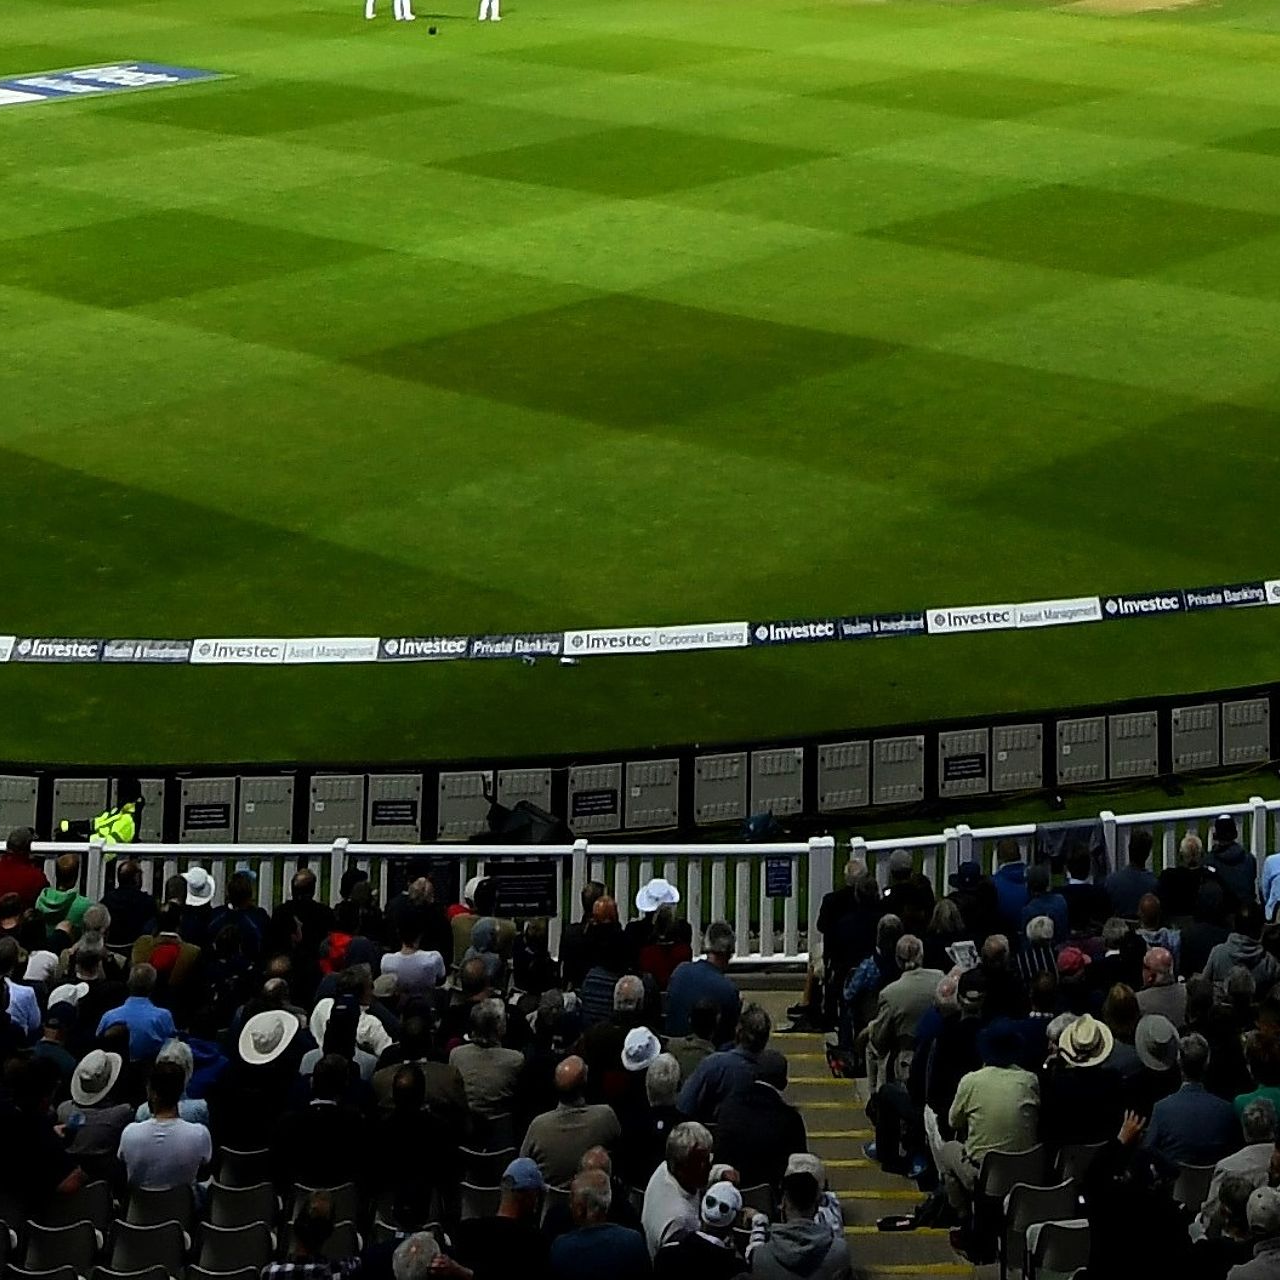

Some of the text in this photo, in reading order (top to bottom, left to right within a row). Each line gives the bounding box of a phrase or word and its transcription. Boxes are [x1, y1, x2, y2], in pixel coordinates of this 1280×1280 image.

[1117, 586, 1265, 616] Investec Private Banking
[947, 610, 1010, 628] Investec
[585, 628, 745, 650] Investec Corporate Banking
[767, 622, 835, 641] Investec
[31, 642, 99, 657] Investec
[212, 642, 279, 658] Investec
[399, 638, 560, 656] Investec Private Banking
